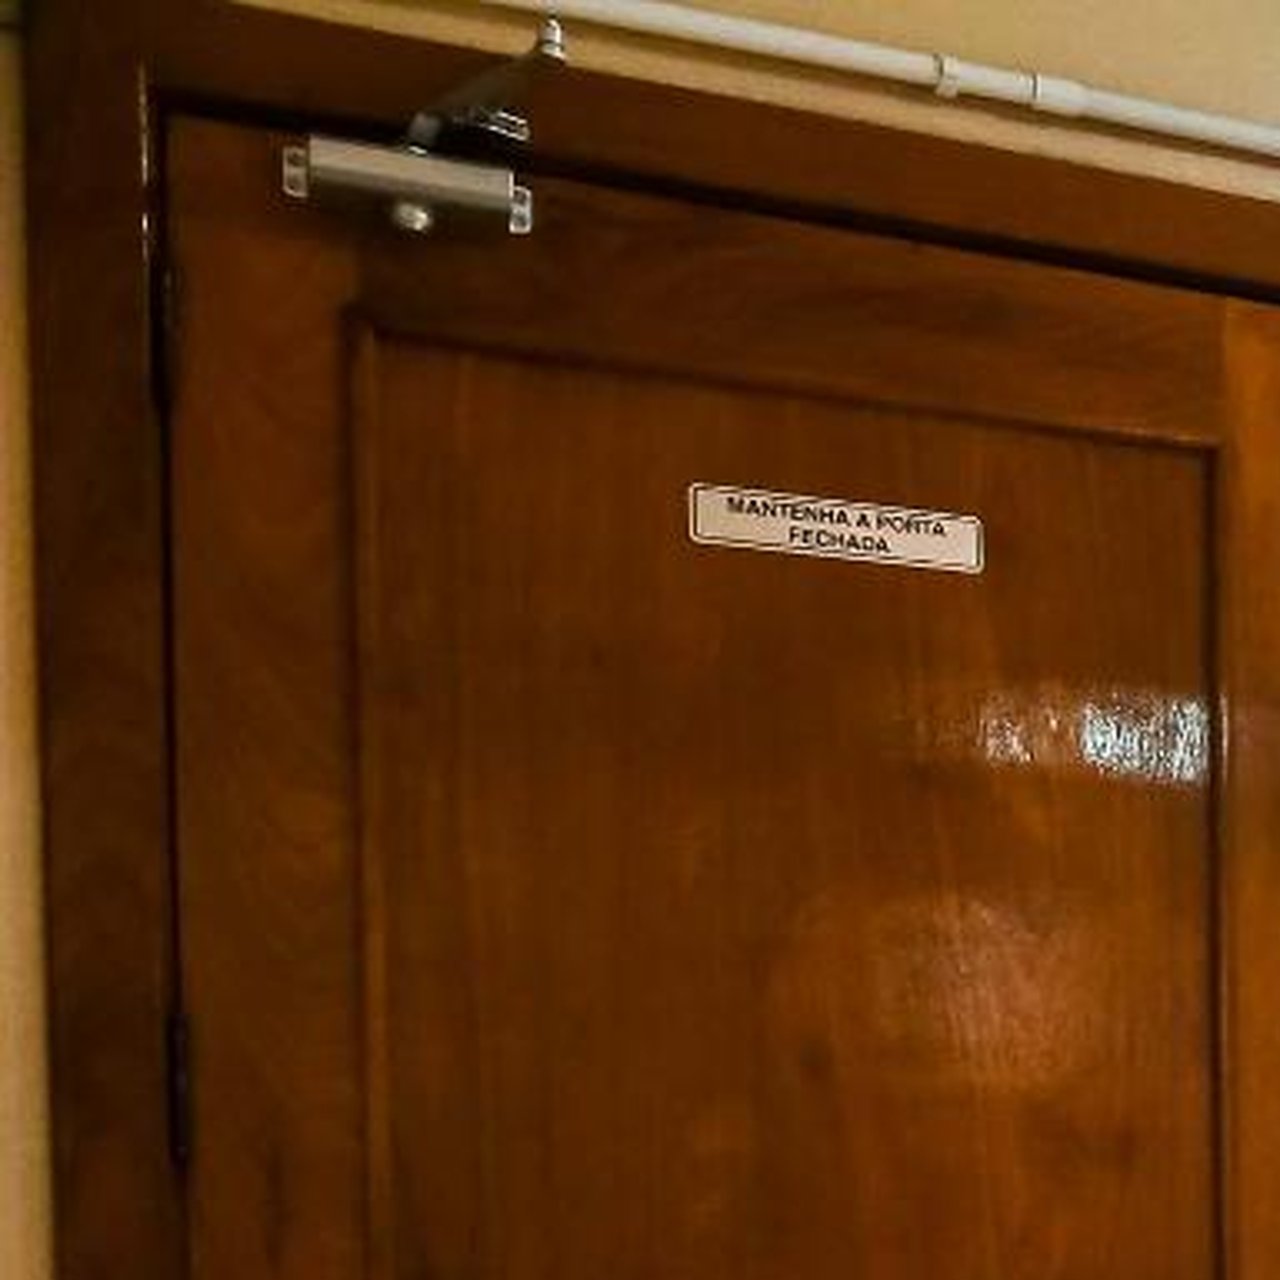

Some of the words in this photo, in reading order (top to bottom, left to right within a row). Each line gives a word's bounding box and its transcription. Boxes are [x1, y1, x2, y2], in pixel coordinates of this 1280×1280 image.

[726, 496, 851, 528] MANTENHA
[856, 513, 871, 529] A
[876, 514, 946, 537] PORTA
[789, 525, 891, 553] FECHADA
